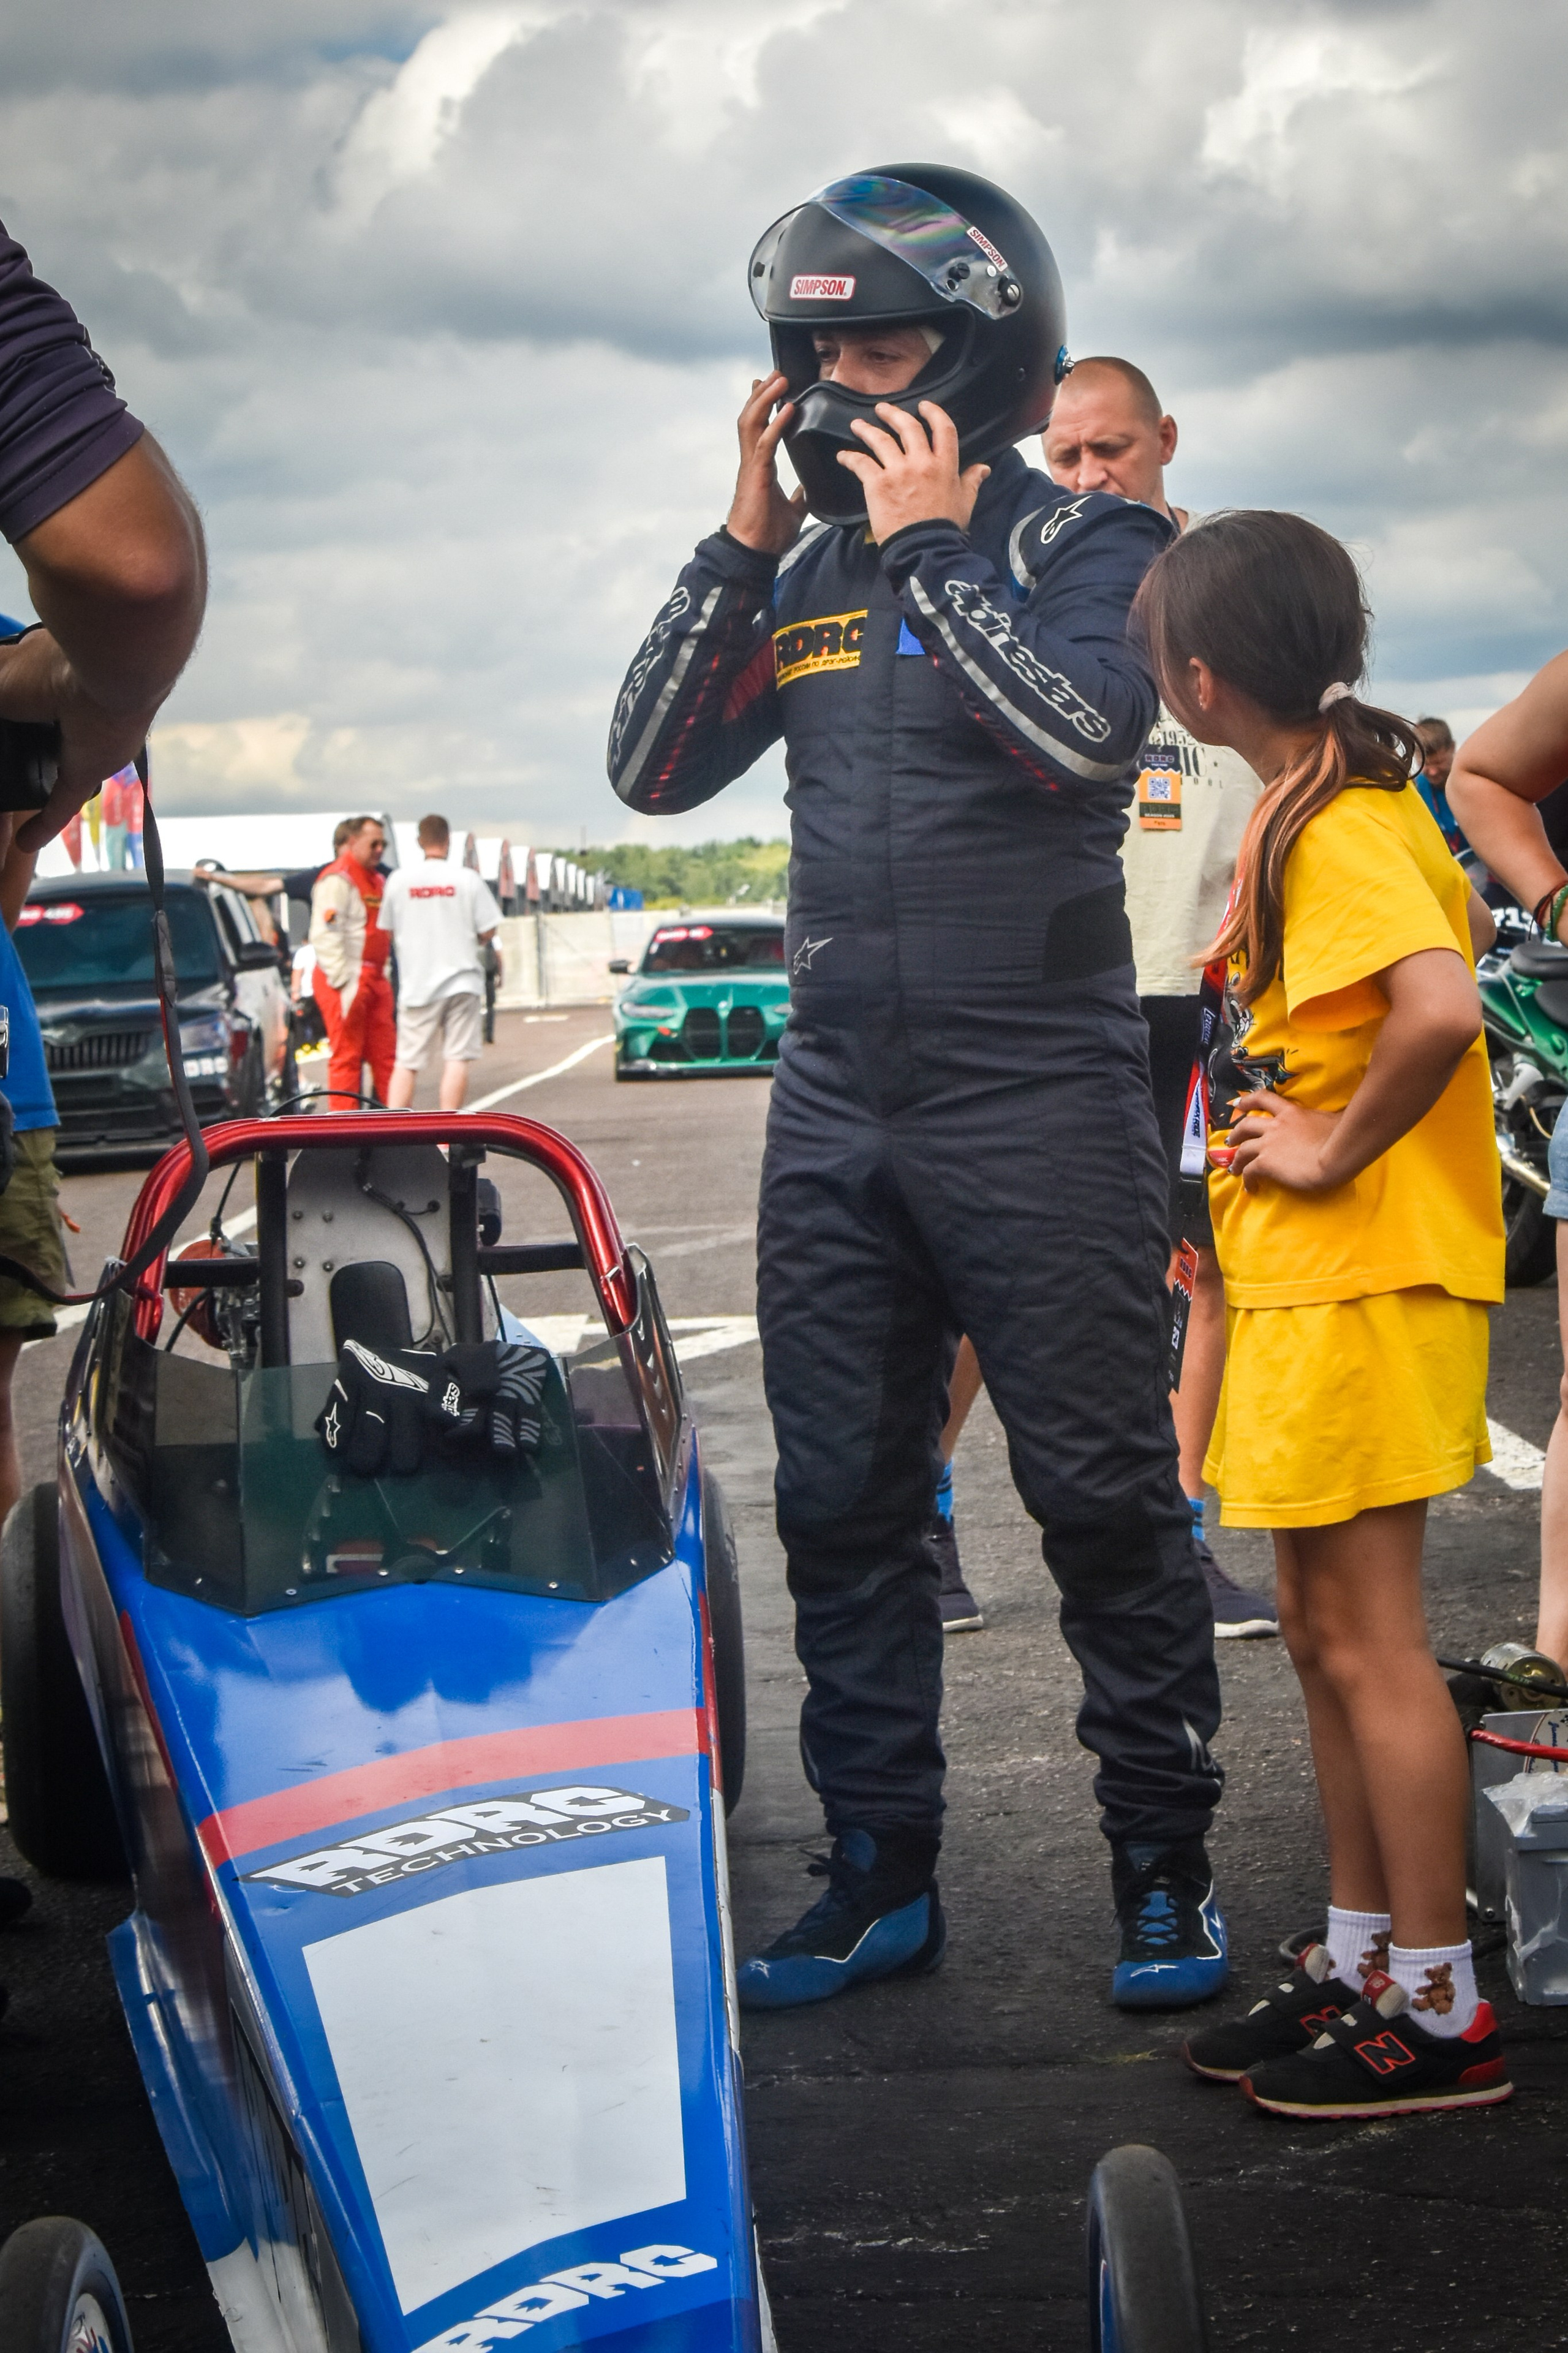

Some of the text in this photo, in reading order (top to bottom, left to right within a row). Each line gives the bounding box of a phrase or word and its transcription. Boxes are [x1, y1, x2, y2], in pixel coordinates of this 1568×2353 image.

[970, 229, 1005, 267] SIMPSON
[794, 279, 846, 295] SIMPSON
[775, 617, 866, 673] RDRC
[1180, 746, 1206, 776] IC
[167, 1056, 229, 1078] DRC
[251, 1785, 645, 1887] RDRC
[332, 1809, 674, 1894] TECHNOLOGY
[1353, 2030, 1416, 2075] N
[410, 2244, 718, 2353] RDRC
